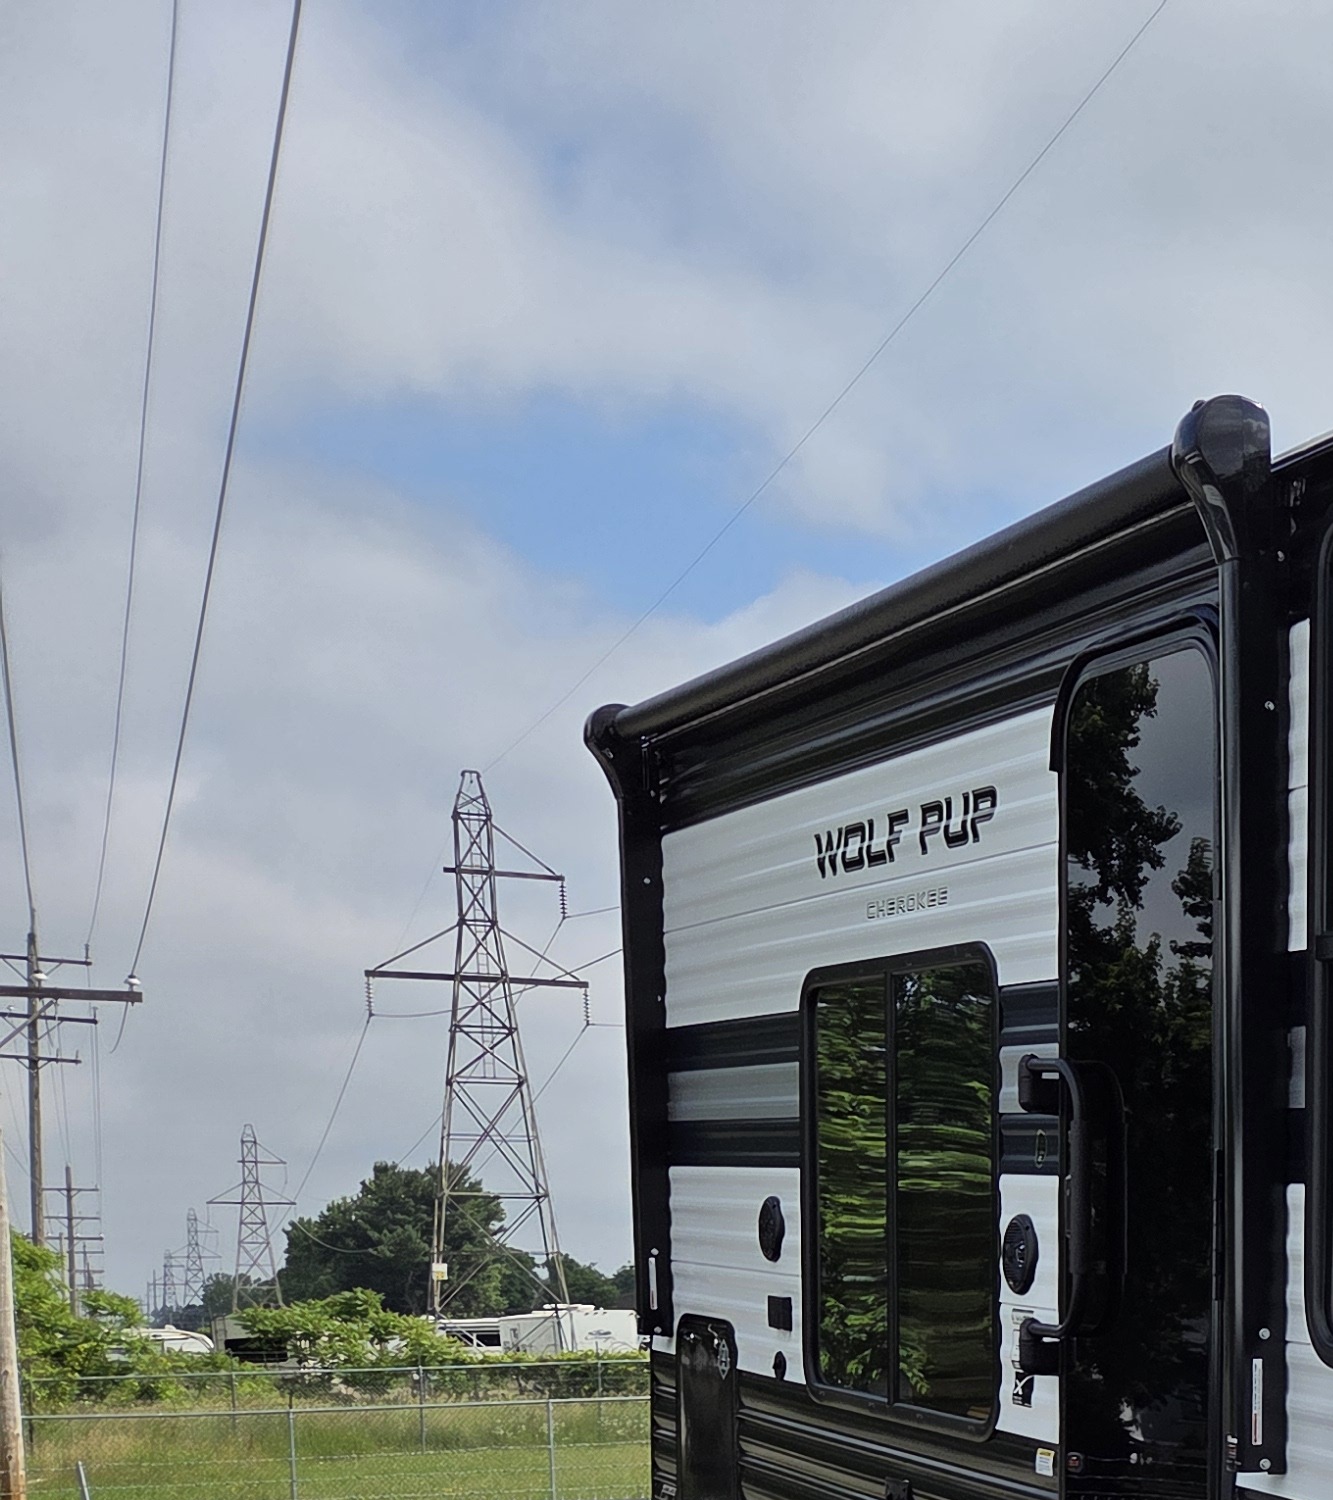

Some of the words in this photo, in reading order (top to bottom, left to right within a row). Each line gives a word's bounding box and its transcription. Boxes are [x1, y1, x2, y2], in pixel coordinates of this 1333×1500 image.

[814, 808, 910, 880] WOLF
[919, 785, 998, 856] PUP
[866, 886, 949, 920] CHEROKEE
